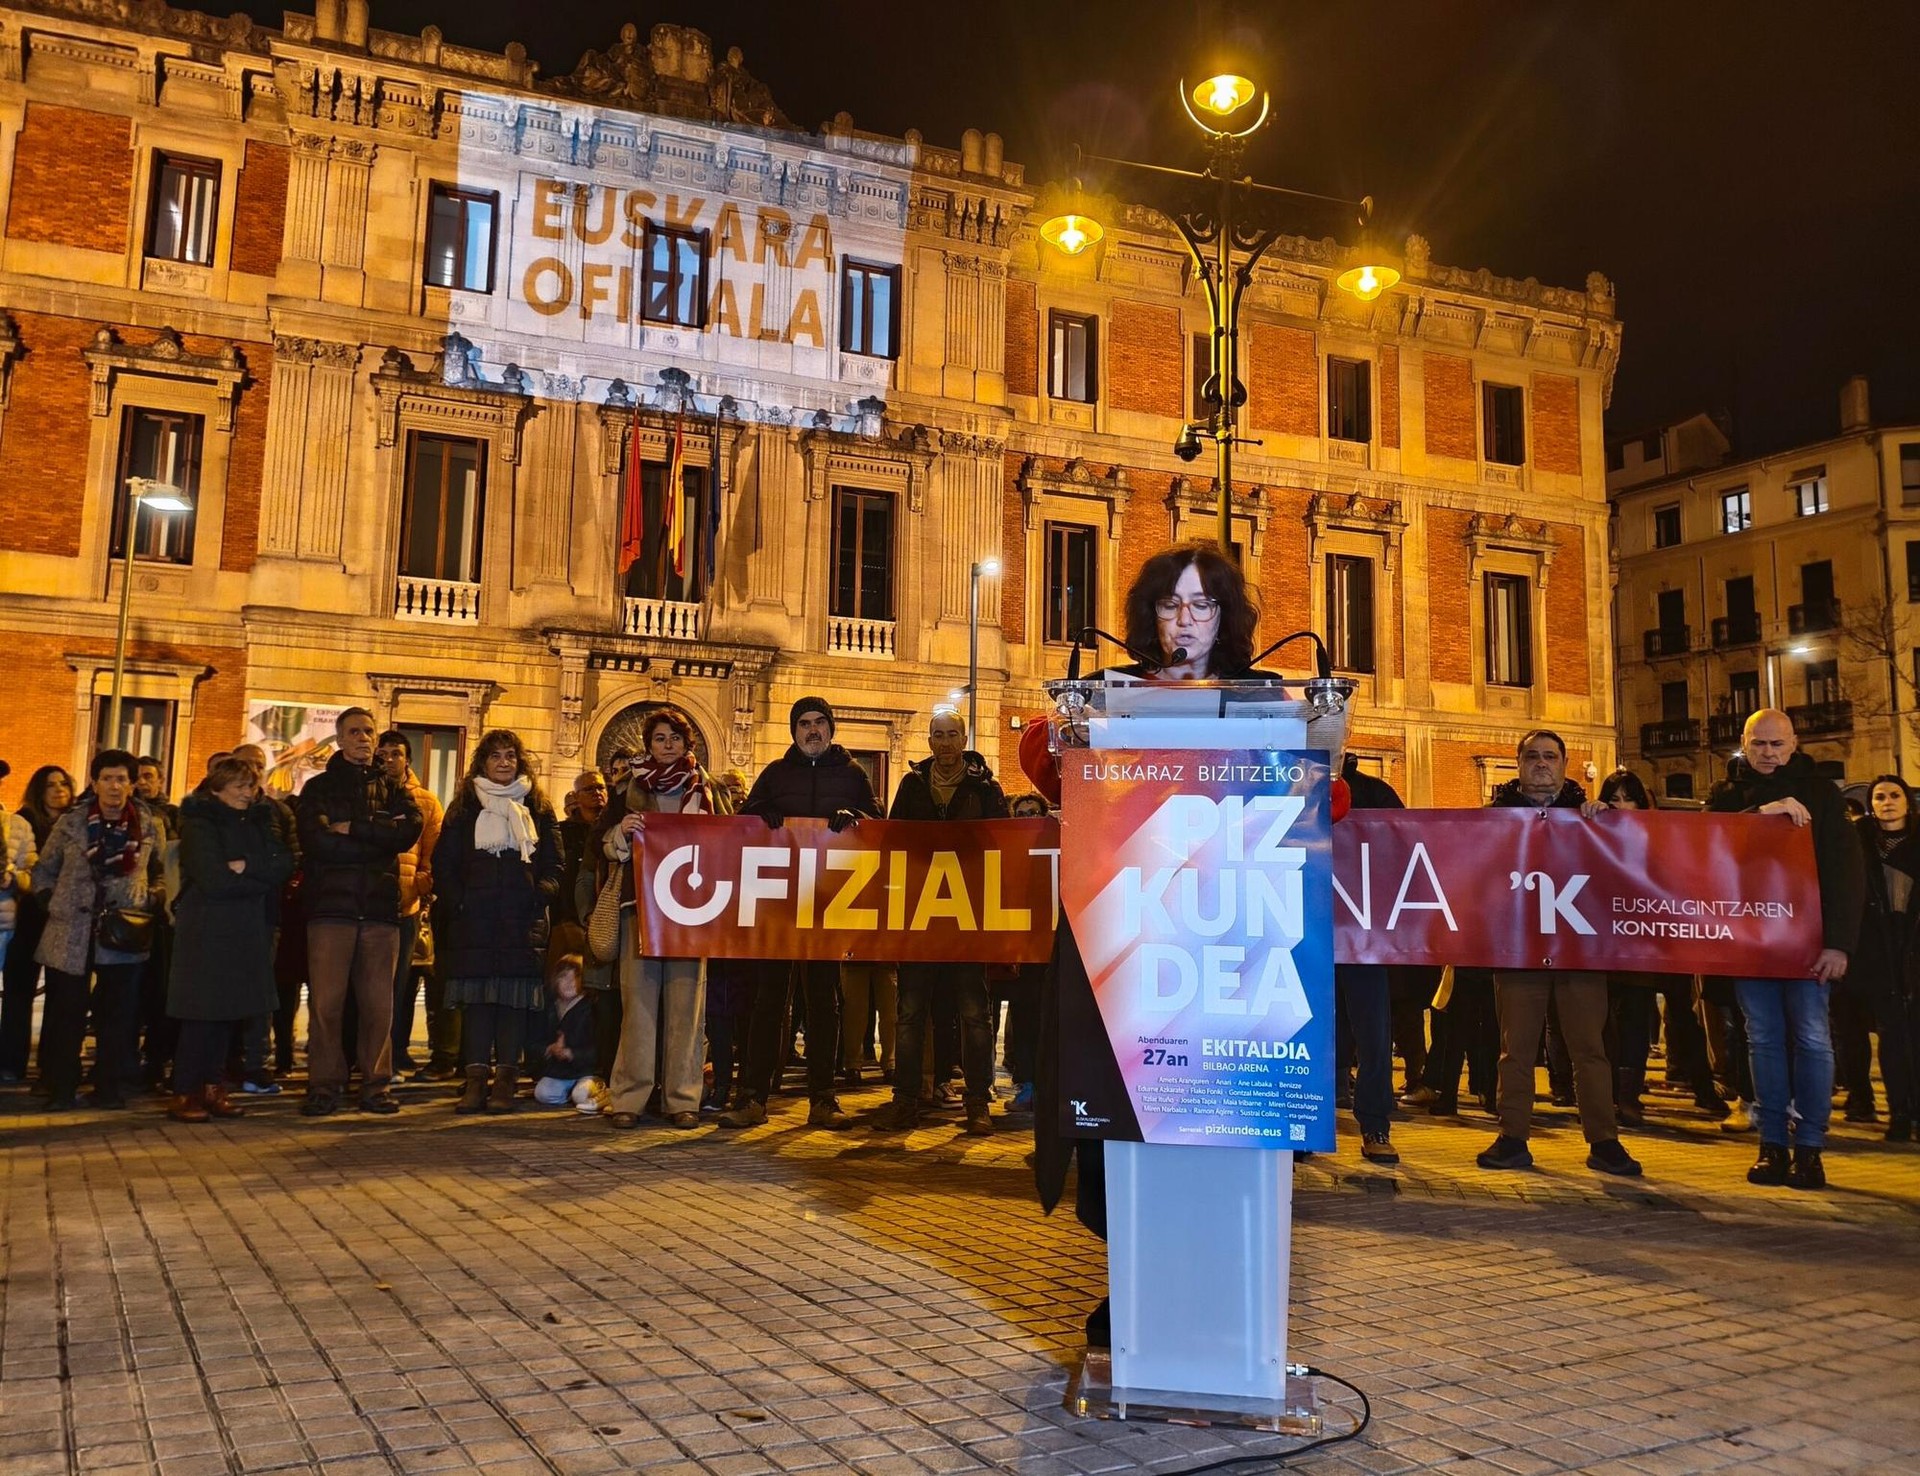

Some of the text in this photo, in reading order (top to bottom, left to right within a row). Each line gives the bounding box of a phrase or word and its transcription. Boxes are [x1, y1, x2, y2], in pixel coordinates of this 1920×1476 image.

[531, 178, 837, 273] EUSKARA
[522, 256, 826, 348] OFIZIALA
[1083, 764, 1305, 782] EUSKARAZ BIZITZEKO
[1171, 794, 1307, 863] PIZ
[1124, 866, 1304, 939] KUN
[1612, 897, 1794, 919] EUSKALGINTZAREN
[1612, 919, 1734, 942] KONTSEILUA
[1138, 942, 1313, 1018] DEA
[1138, 1036, 1188, 1045] Abenduaren
[1202, 1038, 1310, 1061] EKITALDIA
[1143, 1049, 1188, 1067] 27an
[1202, 1062, 1310, 1075] BILBAO ARENA 17:00
[1229, 1089, 1252, 1097] Gontzal
[1253, 1090, 1280, 1098] Mendibil
[1205, 1124, 1282, 1137] pizkundea.eus
